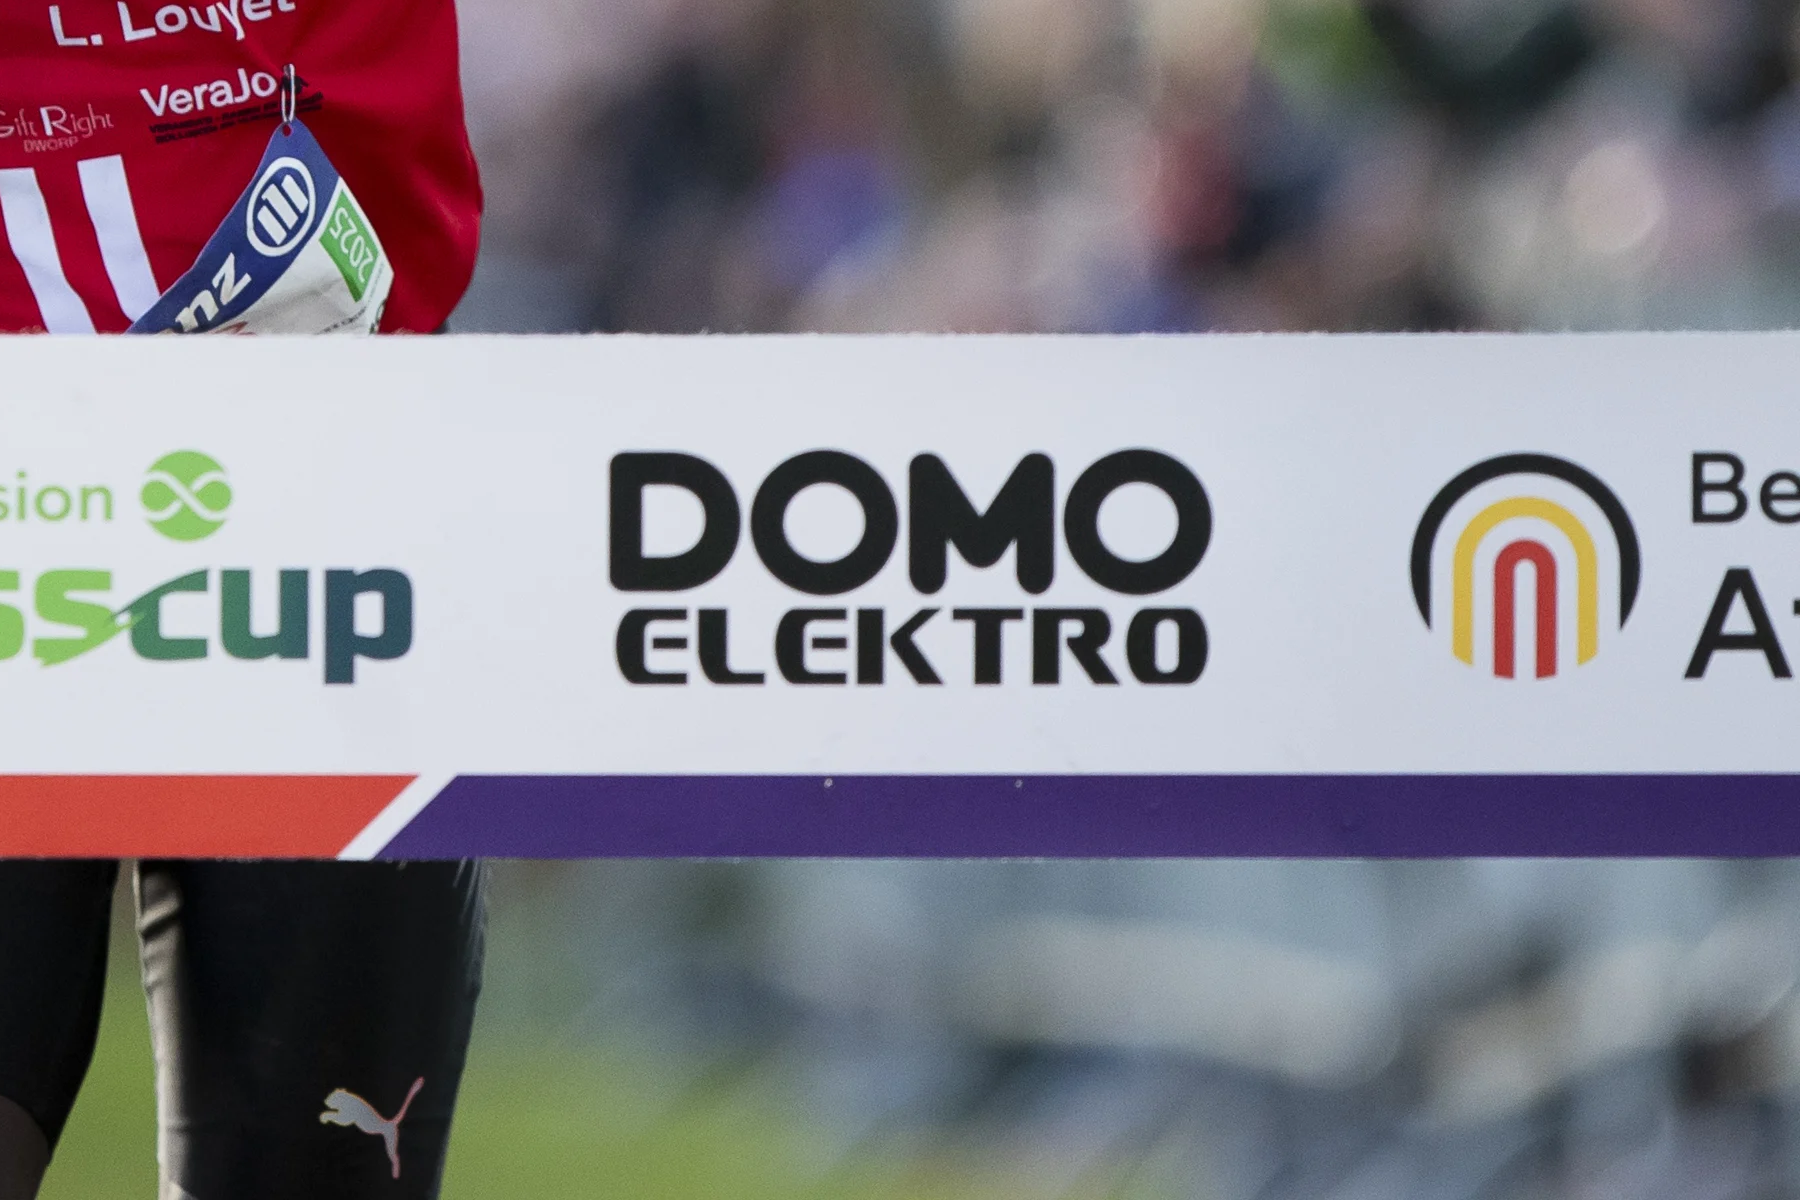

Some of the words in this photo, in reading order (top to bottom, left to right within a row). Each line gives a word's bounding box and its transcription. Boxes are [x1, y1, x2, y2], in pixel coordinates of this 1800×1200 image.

[49, 5, 104, 46] L.
[40, 103, 115, 138] Right
[139, 67, 277, 117] VeraJo
[329, 206, 375, 284] 2025
[609, 447, 1214, 596] DOMO
[615, 607, 1211, 686] ELEKTRO
[1683, 565, 1800, 679] A
